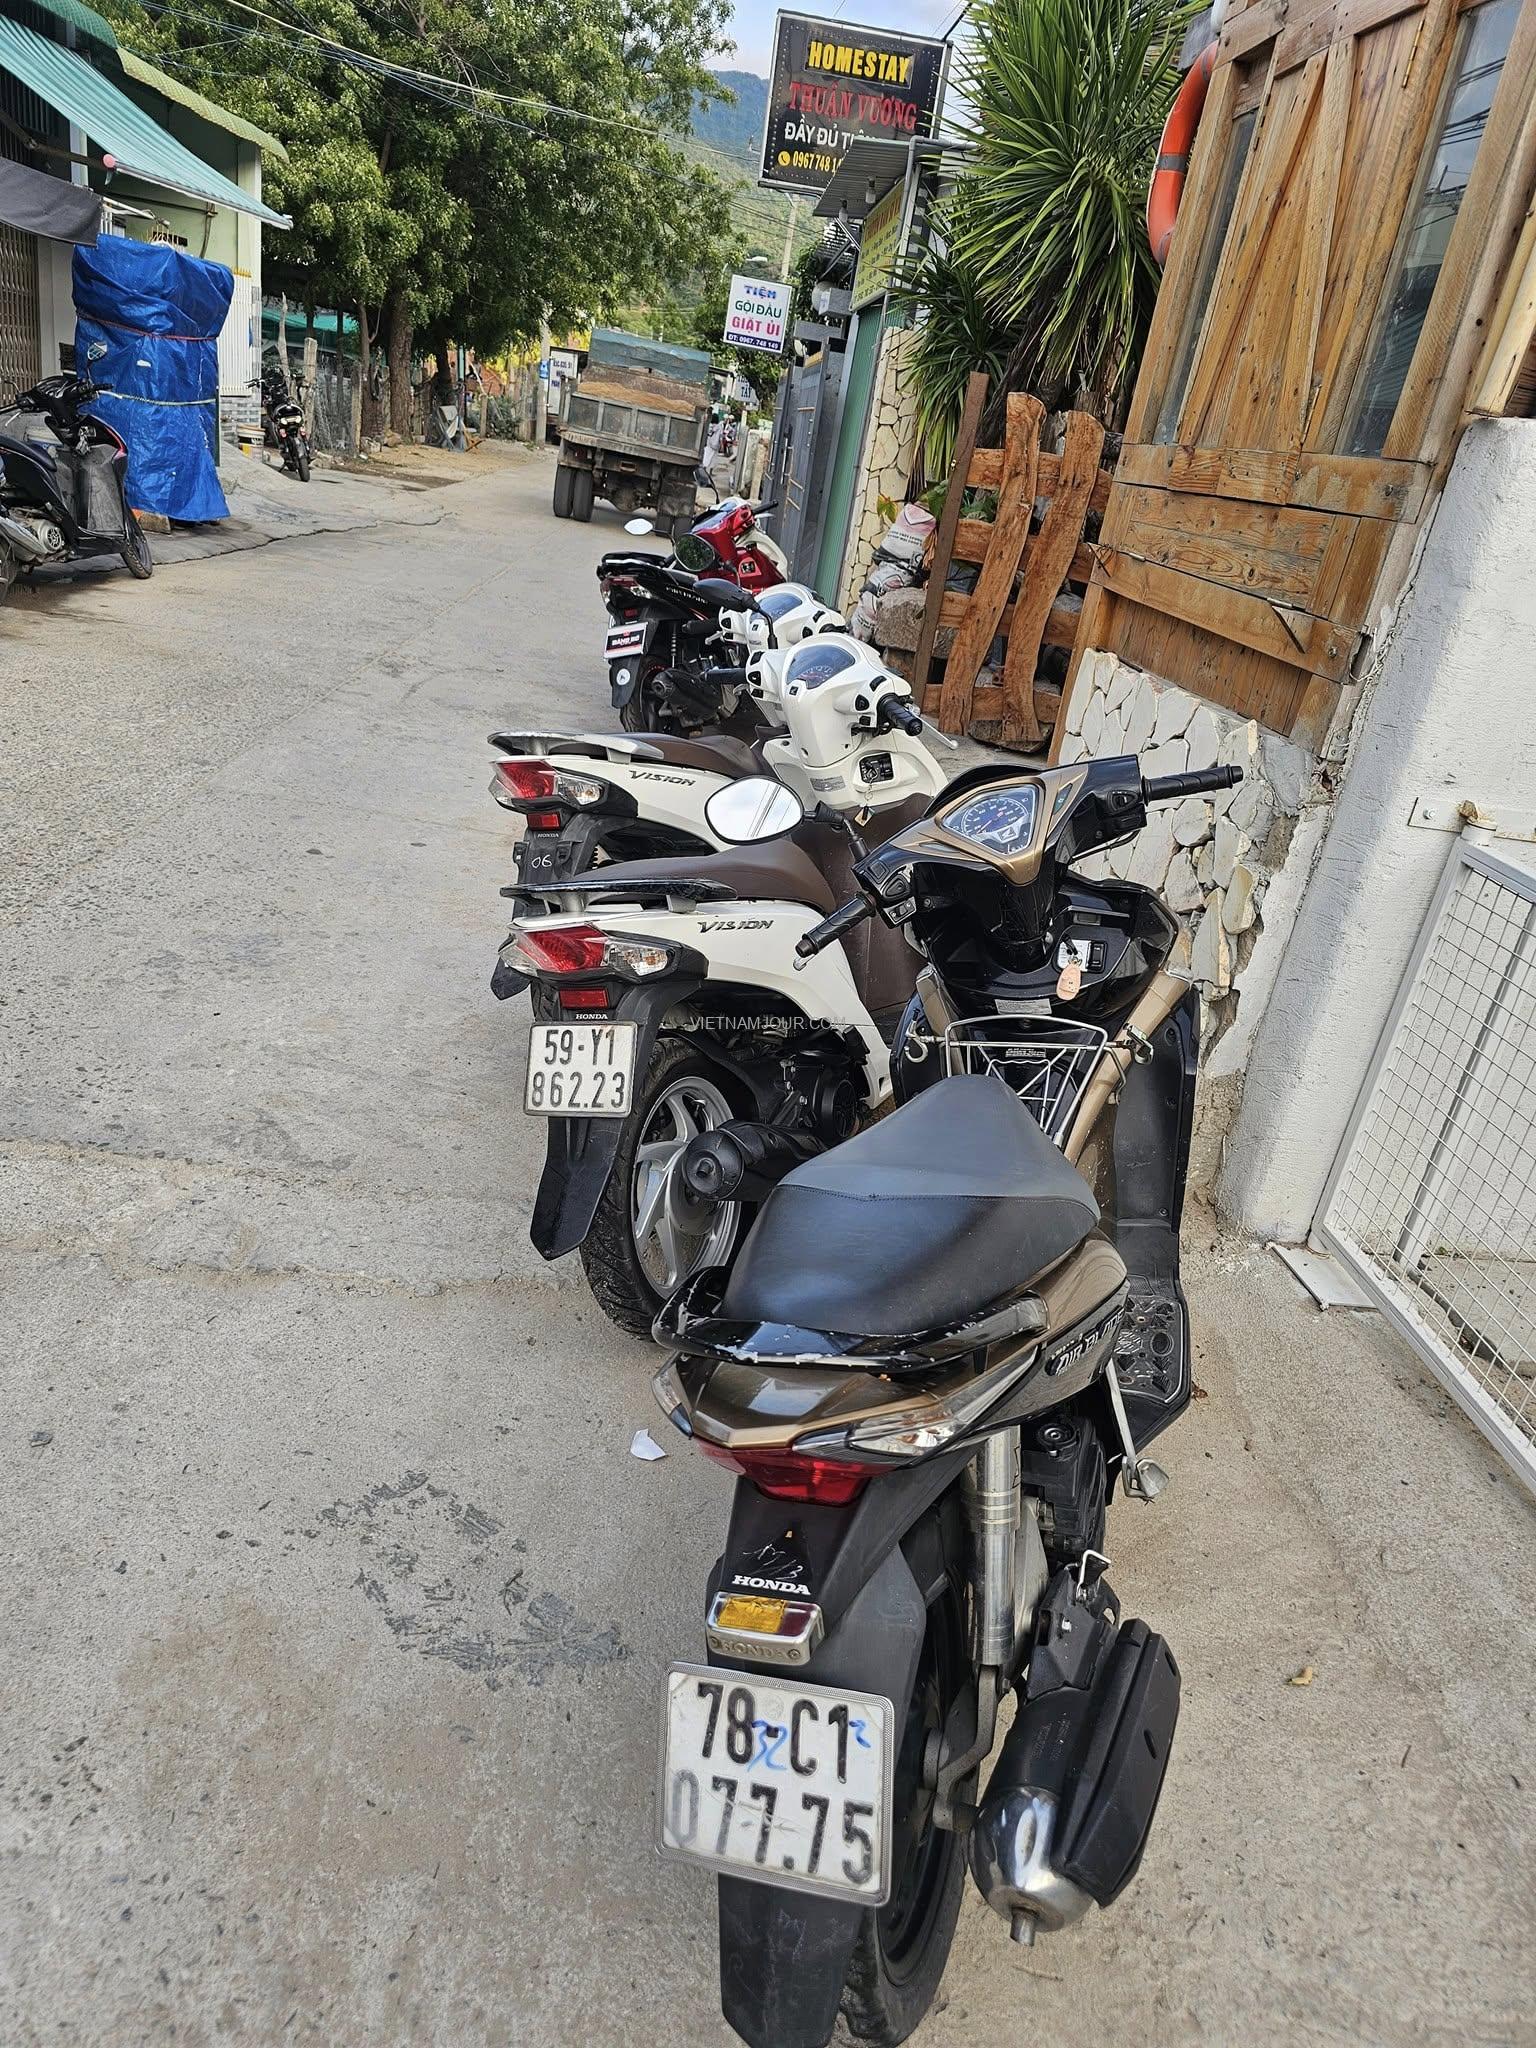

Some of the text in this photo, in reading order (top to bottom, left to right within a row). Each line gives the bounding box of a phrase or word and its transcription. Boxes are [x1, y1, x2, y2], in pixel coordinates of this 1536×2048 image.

[808, 41, 911, 83] HOMESTAY
[858, 92, 917, 131] VƯƠNG
[784, 114, 815, 144] ĐẦY
[817, 123, 838, 147] ĐỦ
[793, 150, 814, 169] 0967
[815, 154, 831, 172] 748
[744, 284, 777, 299] TIỆM
[766, 320, 780, 336] ỦI
[628, 770, 696, 787] VISION
[531, 855, 552, 869] 06
[697, 919, 774, 933] VISION
[544, 1029, 616, 1066] 59-Y1
[531, 1071, 626, 1108] 862.23
[732, 1575, 811, 1596] HONDA
[697, 1681, 849, 1784] 78-C1
[671, 1767, 876, 1884] 077.75
